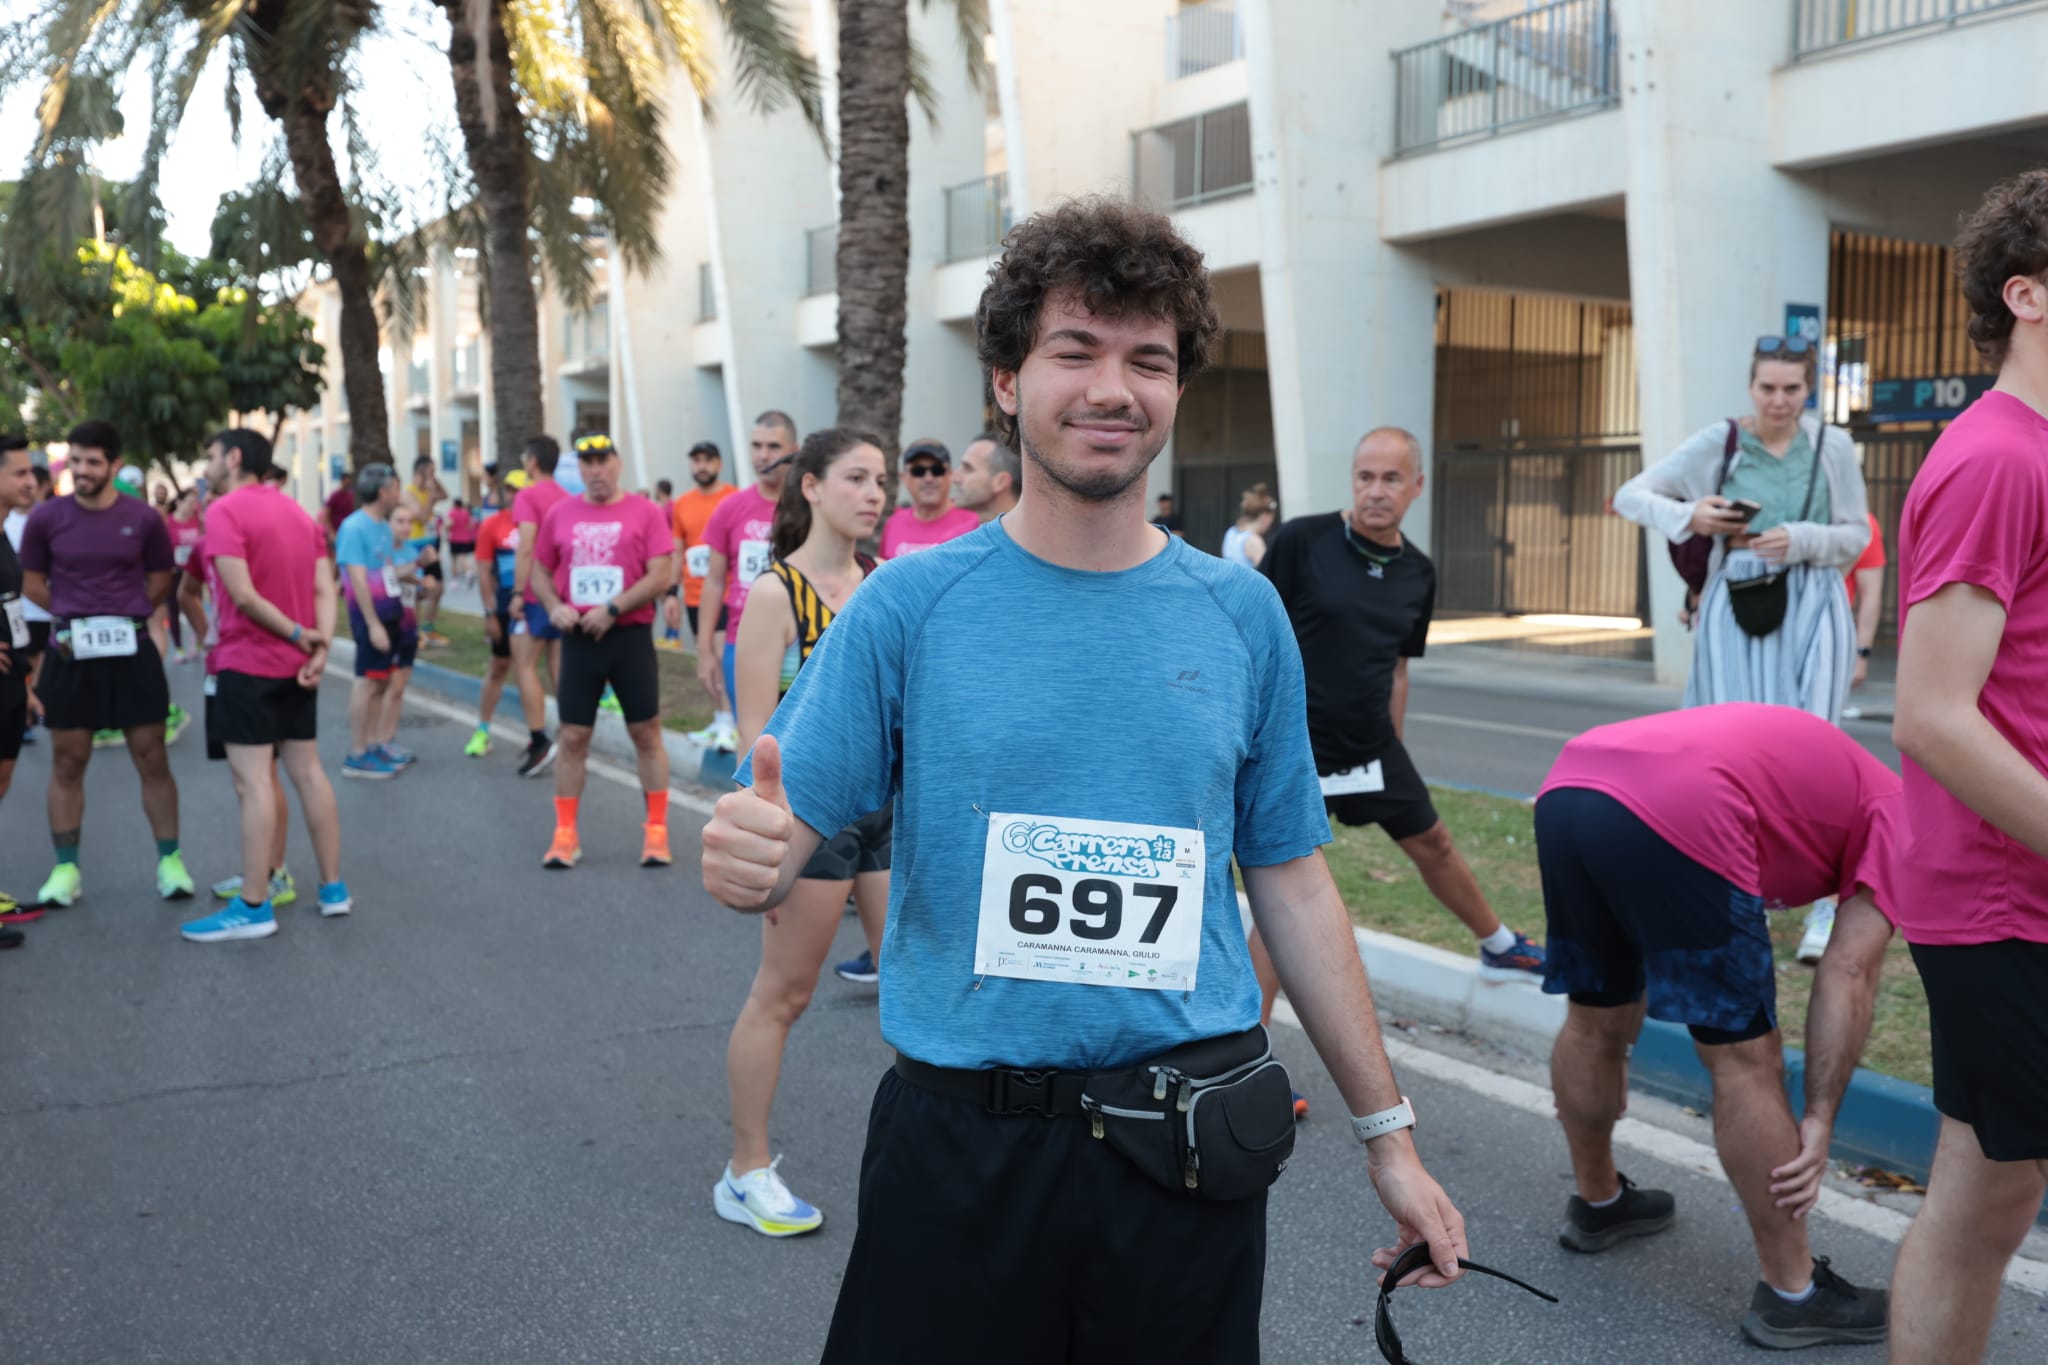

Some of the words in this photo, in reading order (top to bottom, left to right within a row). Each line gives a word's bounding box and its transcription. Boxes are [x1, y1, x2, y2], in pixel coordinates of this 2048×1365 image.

[1788, 315, 1819, 342] P10
[1914, 378, 1967, 408] P10
[577, 579, 616, 595] 517
[81, 629, 129, 646] 182
[1031, 825, 1151, 858] Carrera
[1152, 835, 1173, 849] de
[1154, 848, 1172, 860] la
[1054, 850, 1158, 878] Prensa
[1008, 873, 1179, 944] 697
[1017, 940, 1072, 953] CARAMANNA
[1073, 945, 1131, 958] CARAMANNA,
[1132, 950, 1161, 959] GIULIO
